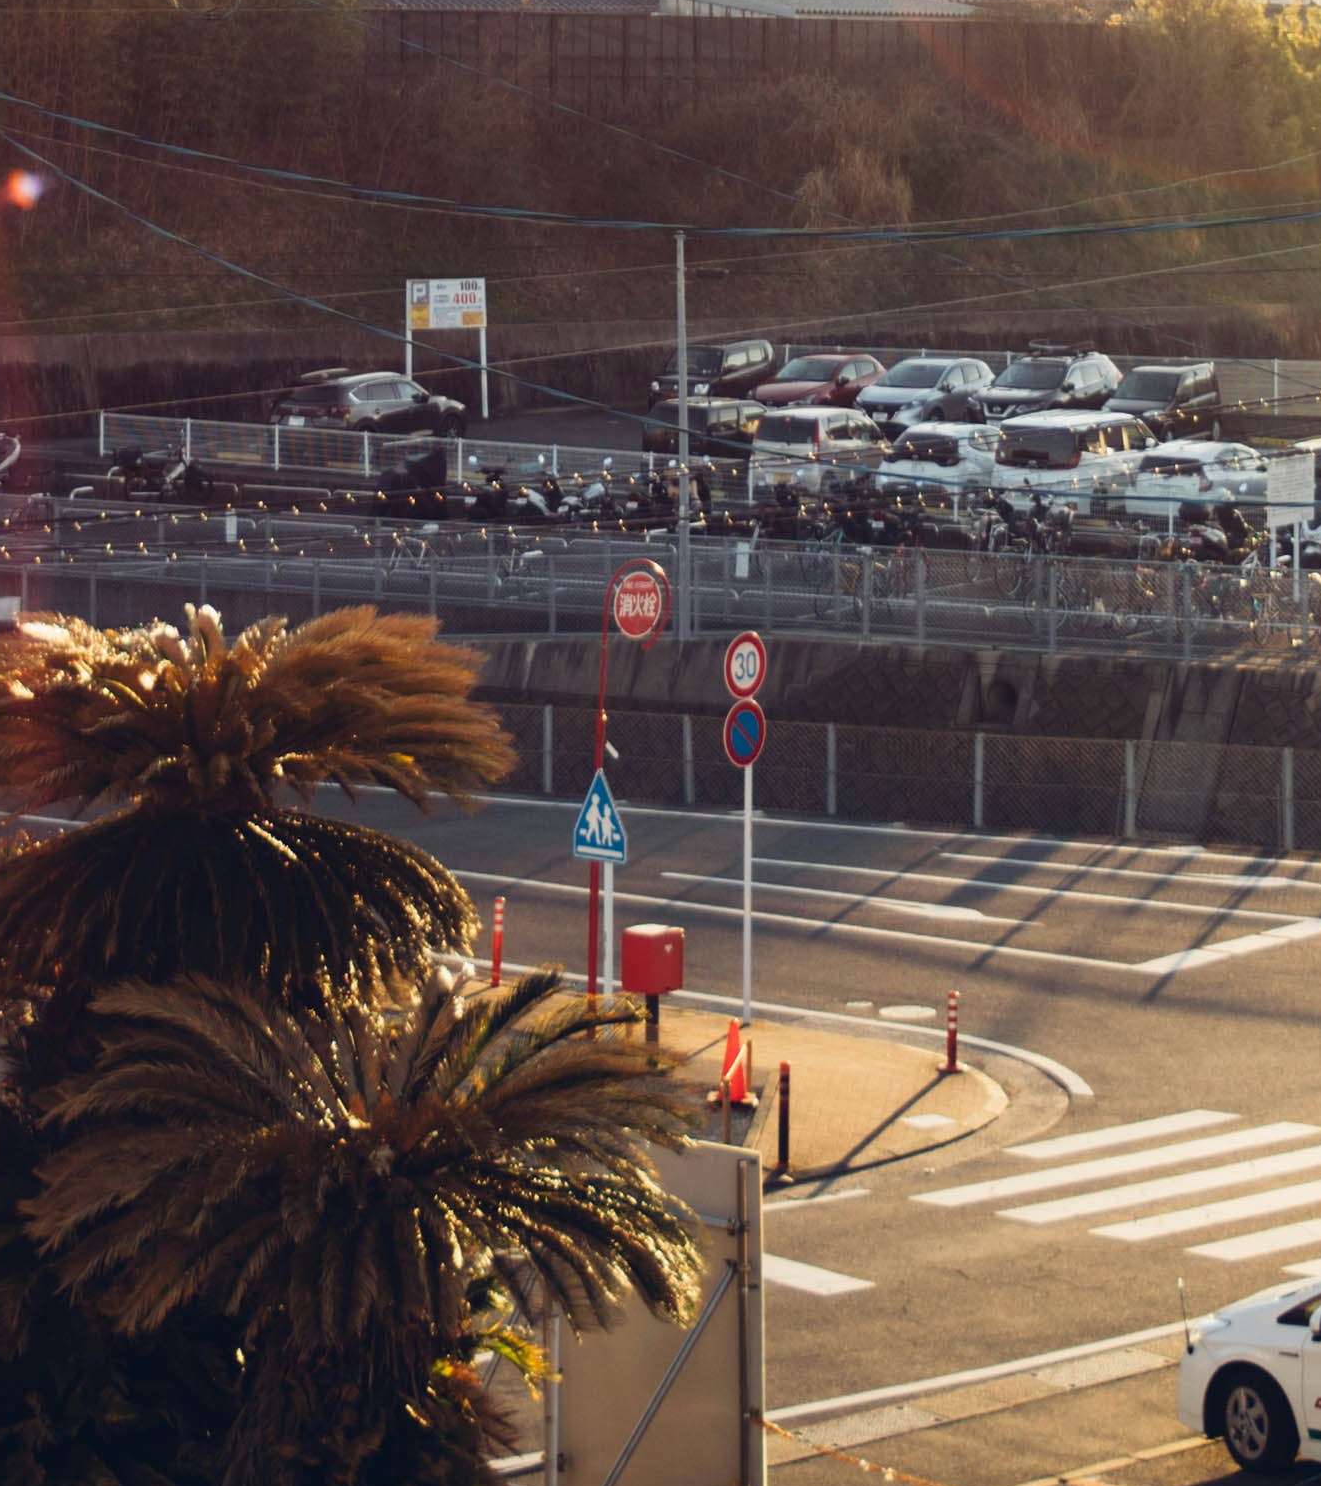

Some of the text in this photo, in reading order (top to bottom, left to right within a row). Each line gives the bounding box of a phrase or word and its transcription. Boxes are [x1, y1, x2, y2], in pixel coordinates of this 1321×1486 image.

[619, 591, 657, 617] 消火栓
[734, 650, 757, 681] 30
